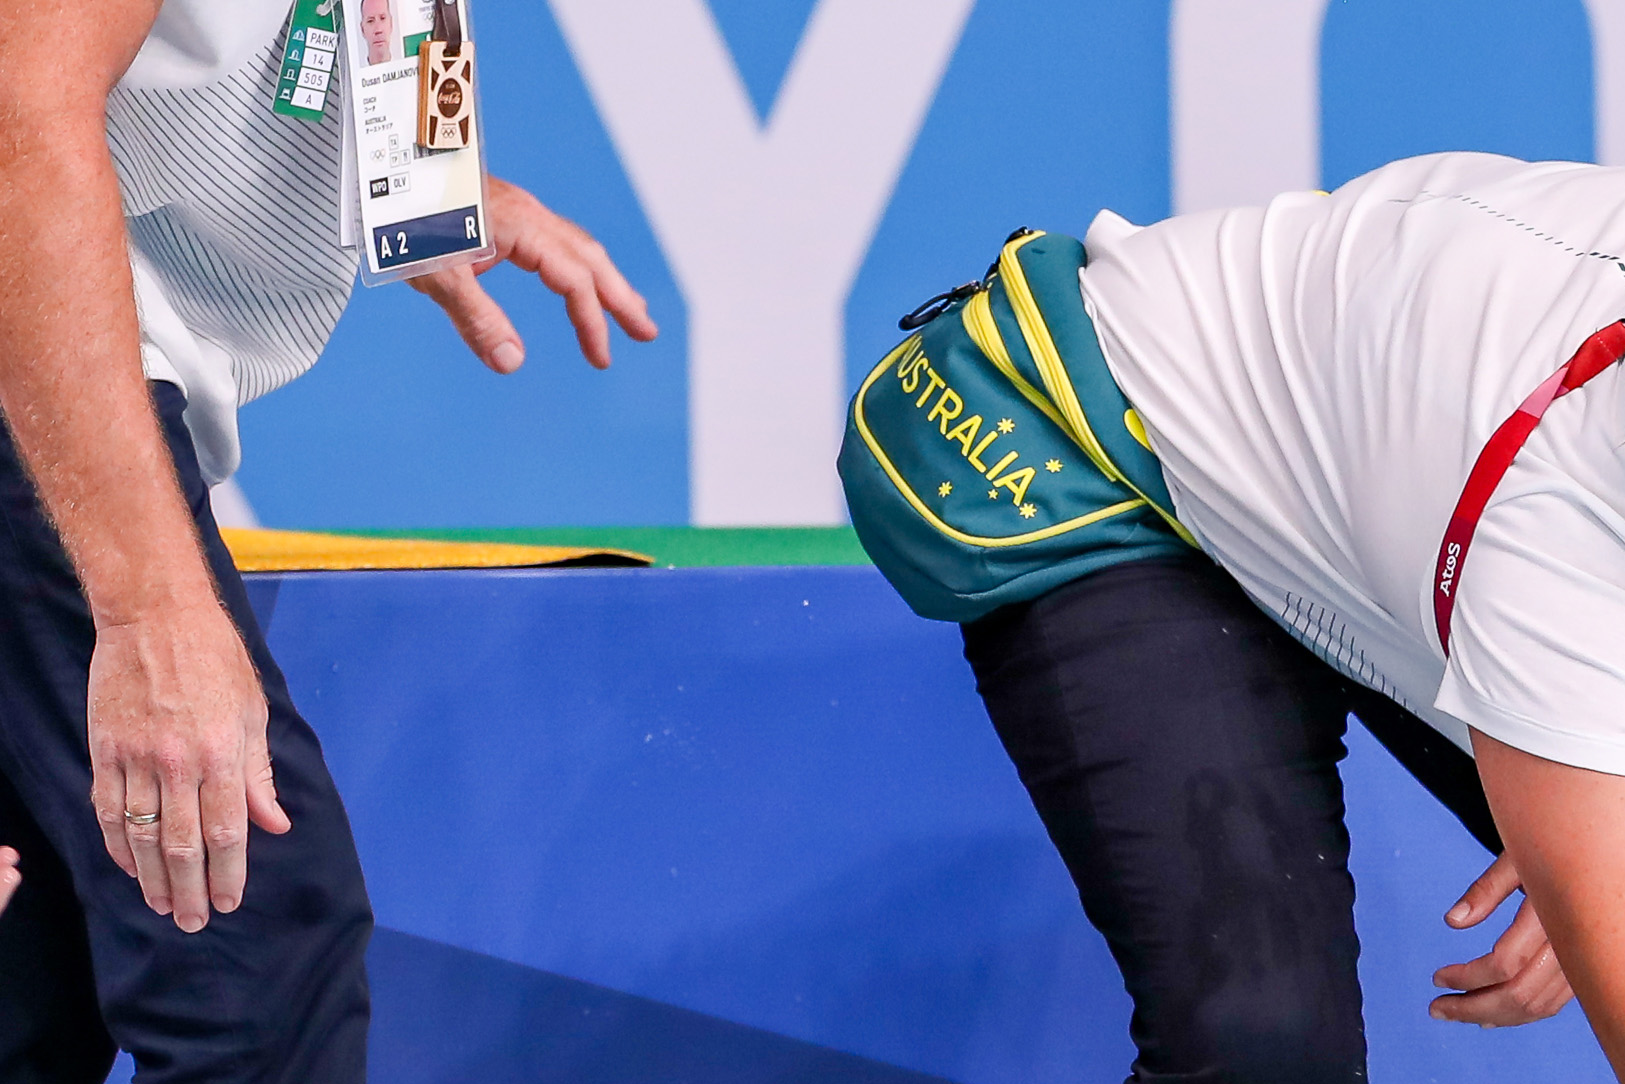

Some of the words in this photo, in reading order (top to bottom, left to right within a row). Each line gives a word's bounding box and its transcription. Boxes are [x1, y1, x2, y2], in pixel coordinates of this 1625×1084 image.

[310, 33, 335, 48] PARK
[313, 54, 324, 66] 14
[303, 73, 323, 86] 505
[361, 77, 381, 88] Dusan
[305, 94, 312, 105] A
[381, 235, 393, 259] A
[396, 231, 409, 255] 2
[464, 215, 478, 240] R
[1439, 542, 1461, 597] Atos
